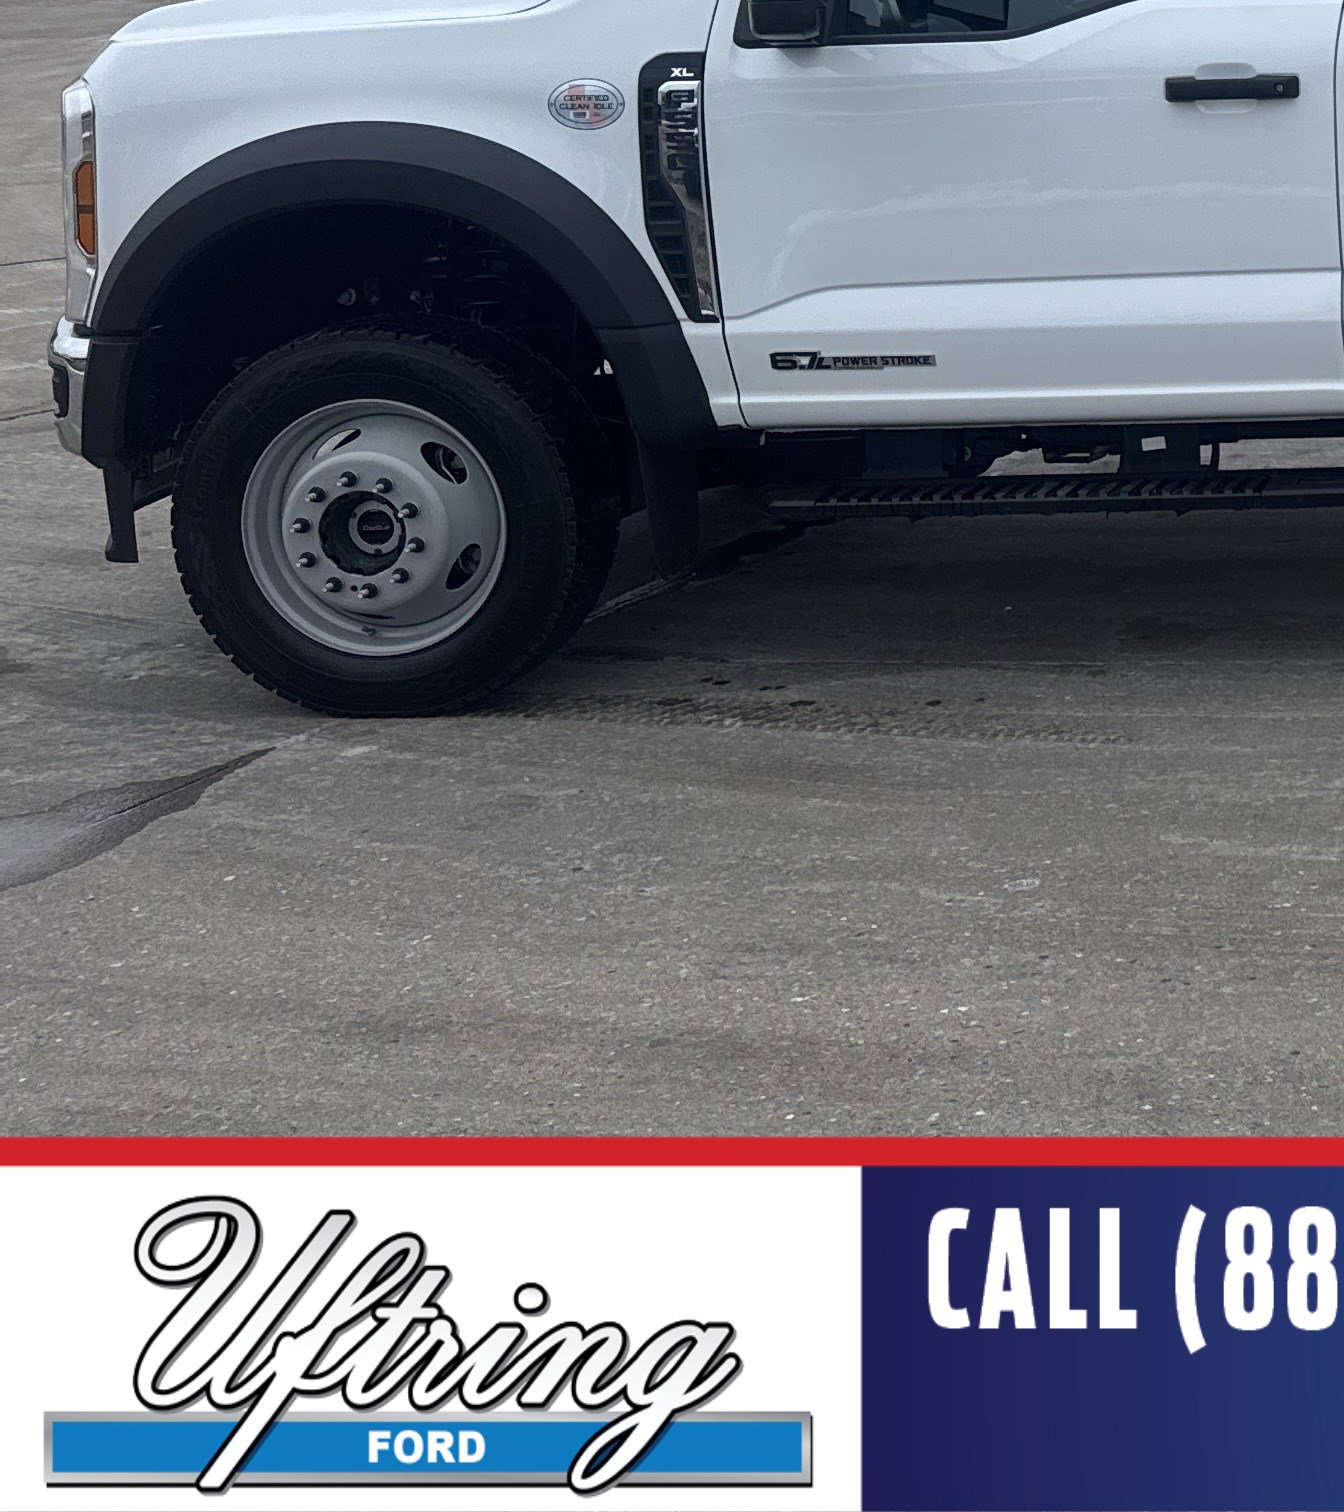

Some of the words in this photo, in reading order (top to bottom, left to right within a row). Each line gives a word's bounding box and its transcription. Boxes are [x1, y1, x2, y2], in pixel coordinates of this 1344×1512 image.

[670, 67, 695, 78] XL
[563, 94, 609, 102] CERTIFIED
[593, 102, 614, 110] IDLE
[833, 356, 878, 366] POWER
[880, 355, 931, 366] STROKE
